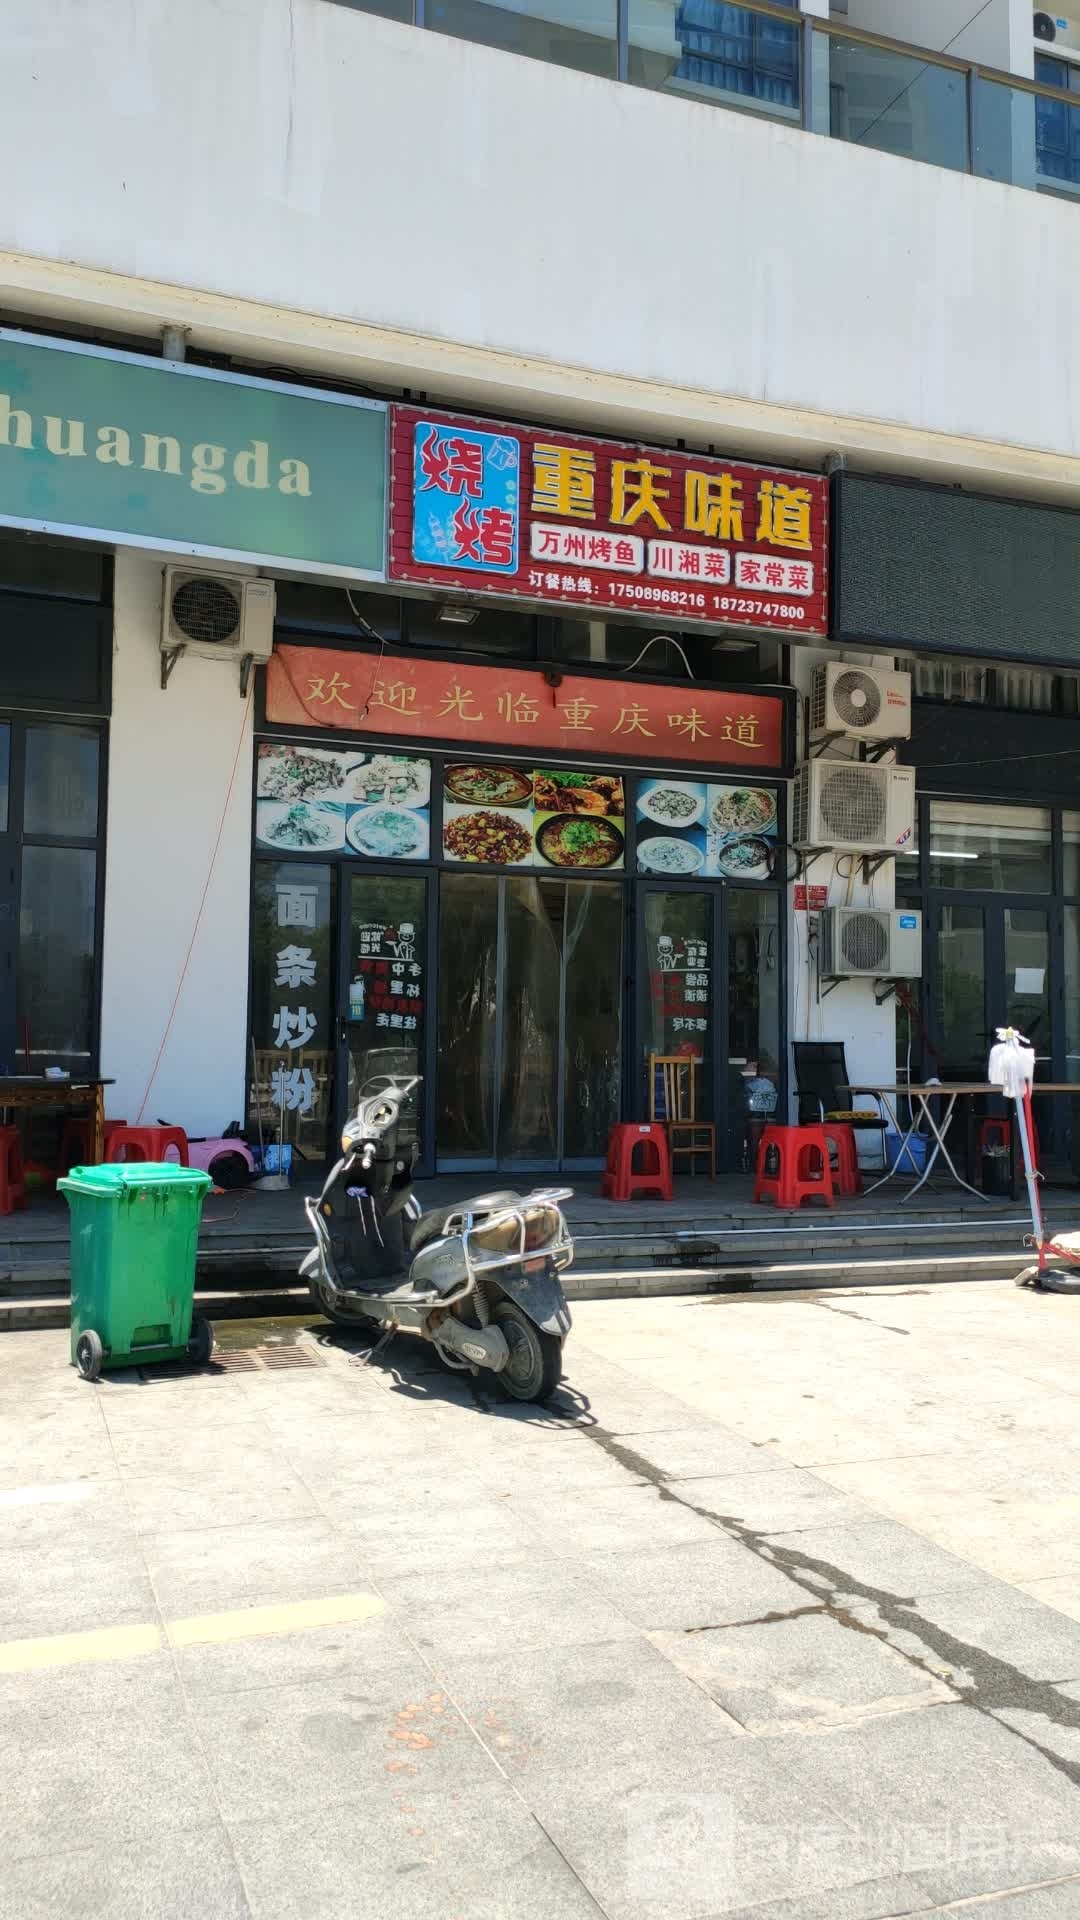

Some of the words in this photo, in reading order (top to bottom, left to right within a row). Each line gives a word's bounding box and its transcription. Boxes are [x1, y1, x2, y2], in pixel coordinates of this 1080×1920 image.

[419, 426, 514, 566] 烧烤
[530, 442, 812, 551] 重庆味道
[537, 528, 637, 567] 万州烤鱼
[652, 545, 727, 579] 川湘菜
[739, 558, 810, 592] 家常菜
[609, 582, 705, 607] 17508968216
[713, 595, 805, 620] 18723747800
[305, 671, 765, 748] 欢迎光临重庆味道
[272, 884, 319, 1111] 面条炒粉
